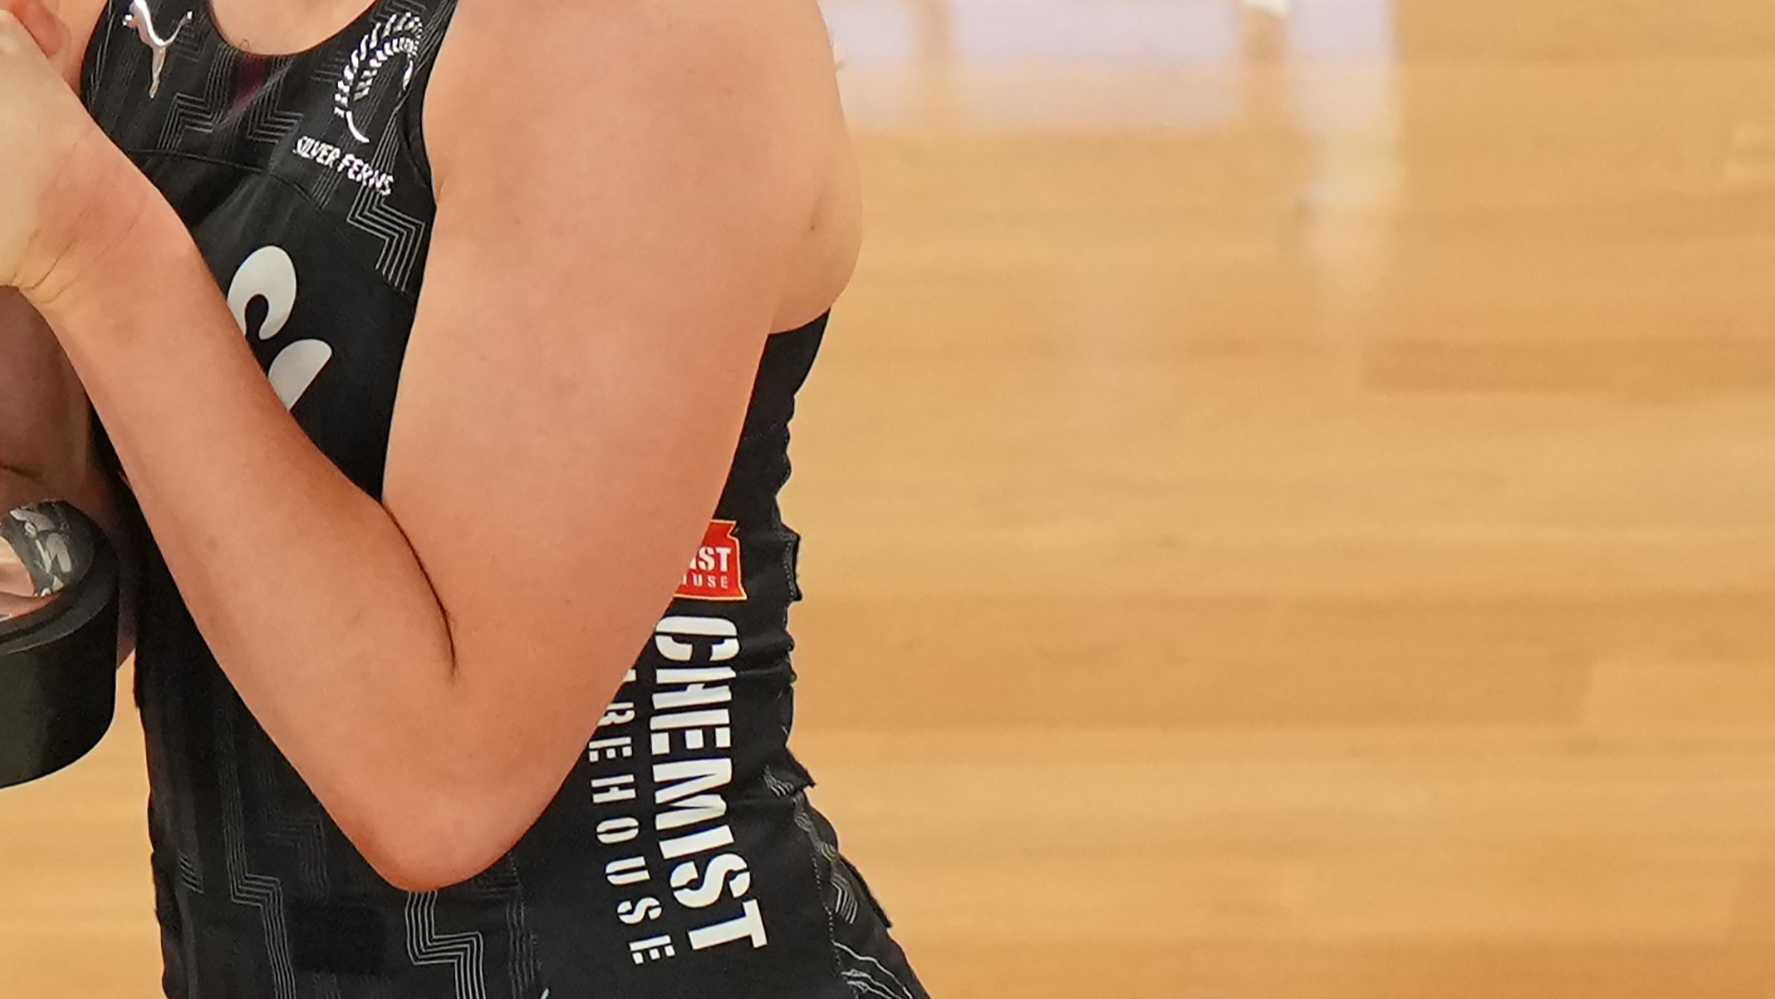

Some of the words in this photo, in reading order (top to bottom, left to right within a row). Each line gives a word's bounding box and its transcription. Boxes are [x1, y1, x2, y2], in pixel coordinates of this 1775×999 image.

[292, 136, 341, 169] SILVER
[337, 153, 394, 196] FERNS
[650, 615, 768, 950] CHEMIST
